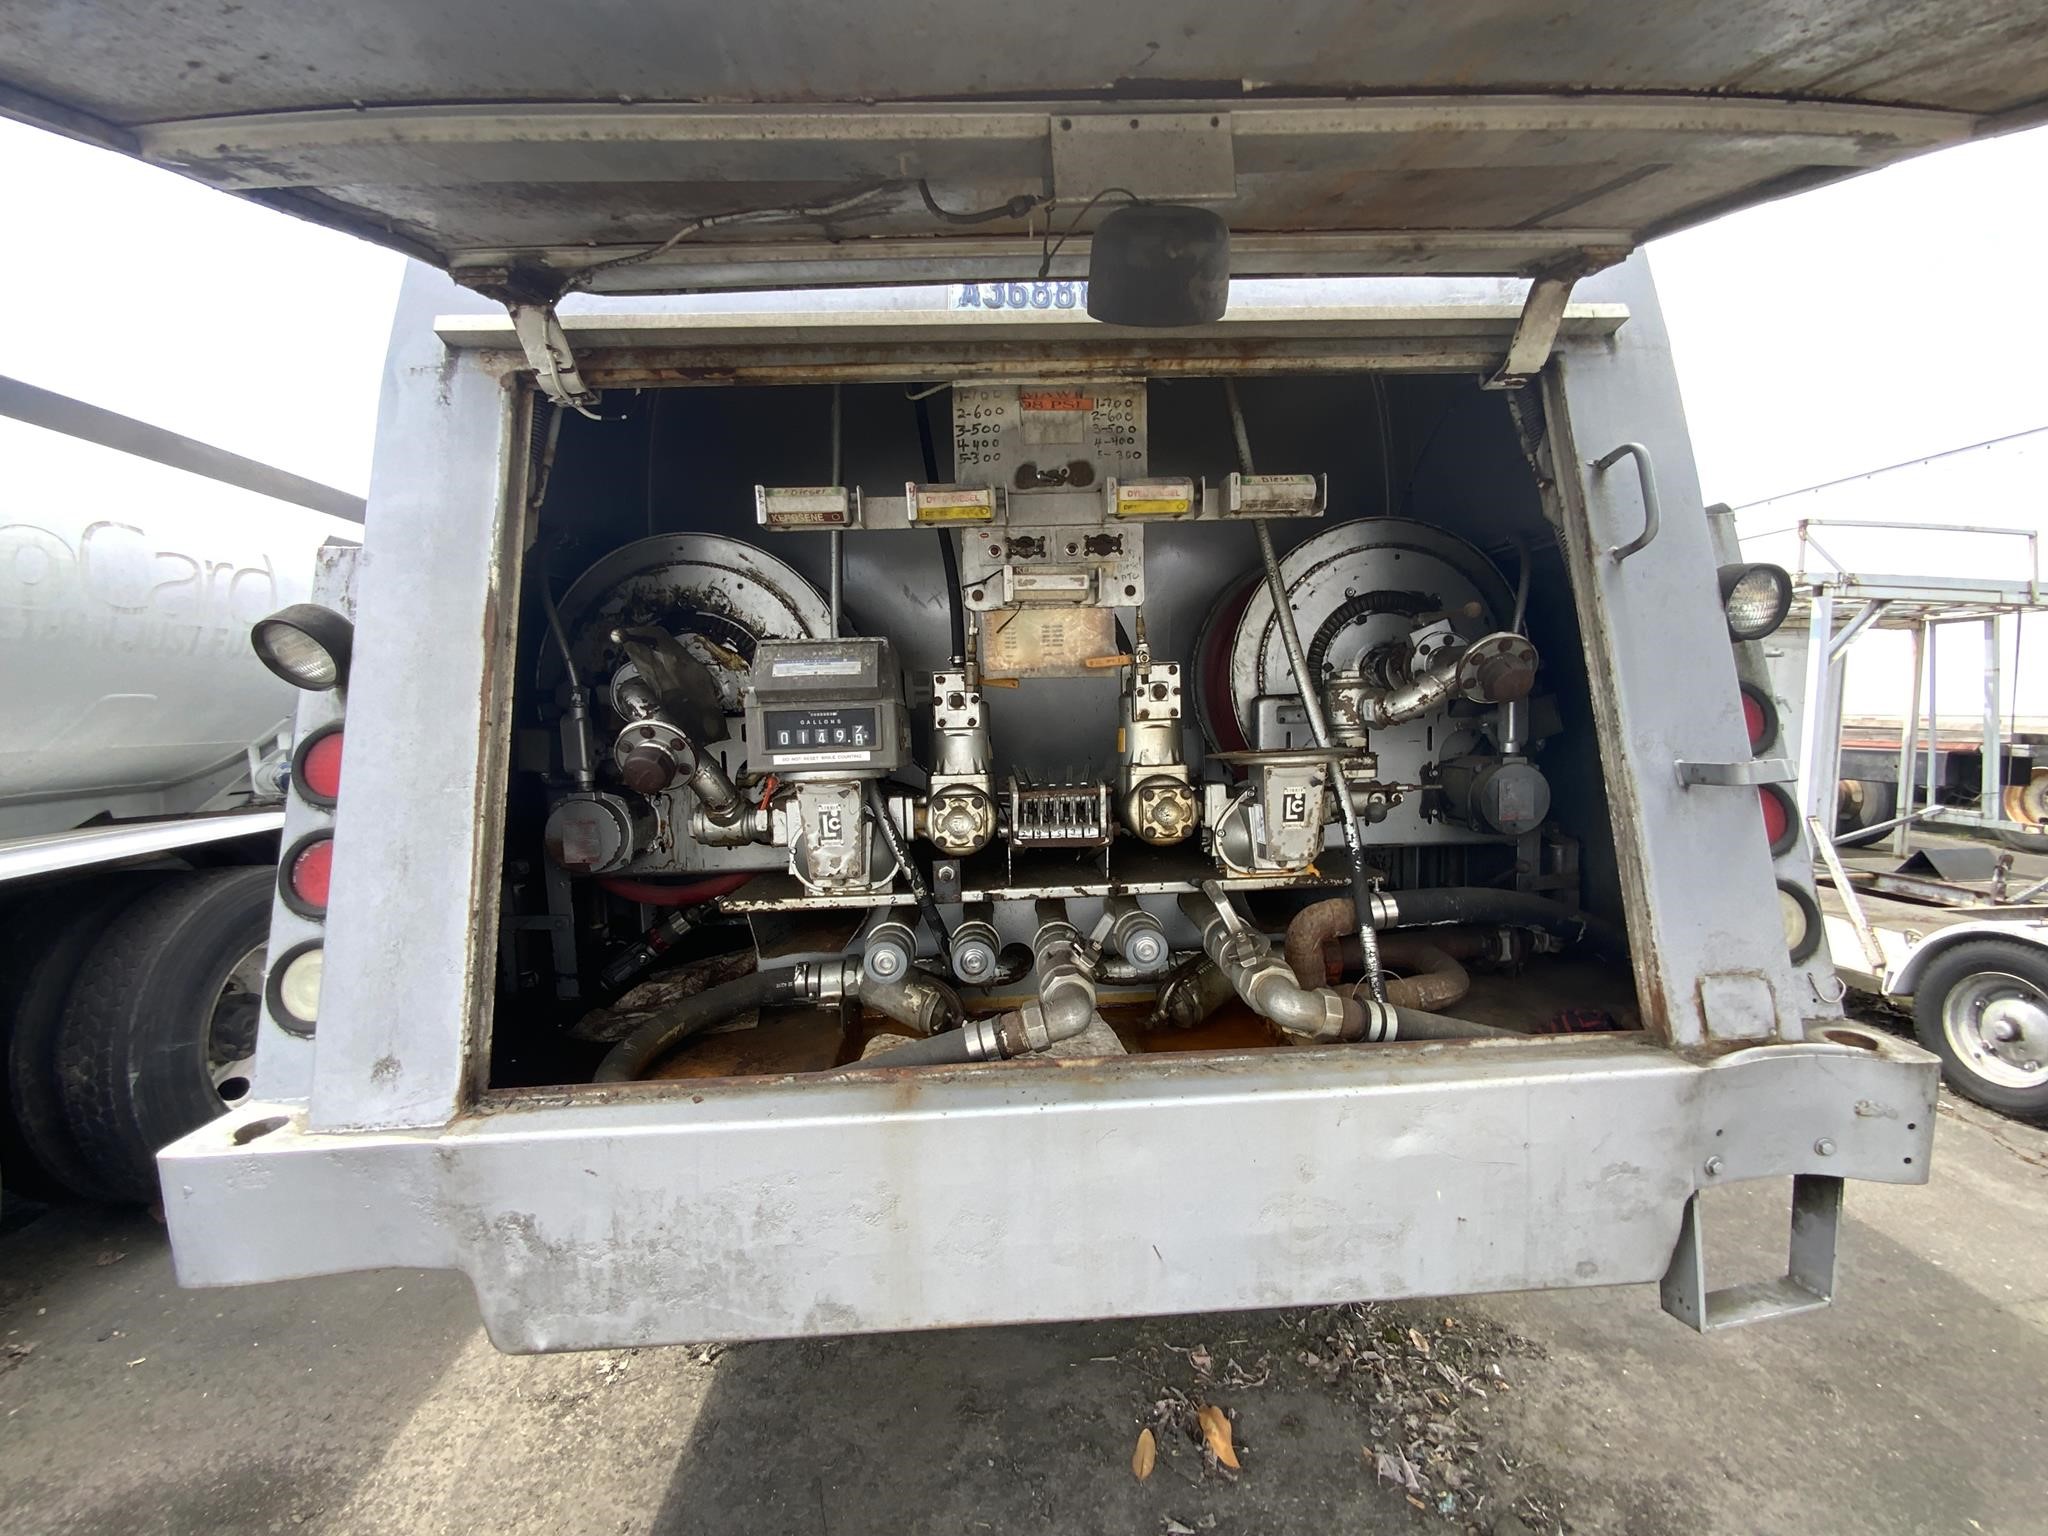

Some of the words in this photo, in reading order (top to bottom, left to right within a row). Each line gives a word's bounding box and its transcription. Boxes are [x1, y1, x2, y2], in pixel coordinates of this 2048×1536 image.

[1095, 397, 1133, 409] 1-700
[956, 404, 1005, 419] 2-600
[1091, 409, 1134, 422] 2-600
[955, 423, 1001, 437] 3-500
[1092, 423, 1137, 435] 3-500
[956, 438, 1000, 452] 4-400
[958, 451, 1001, 465] 5-300
[770, 512, 825, 522] KEROSENE
